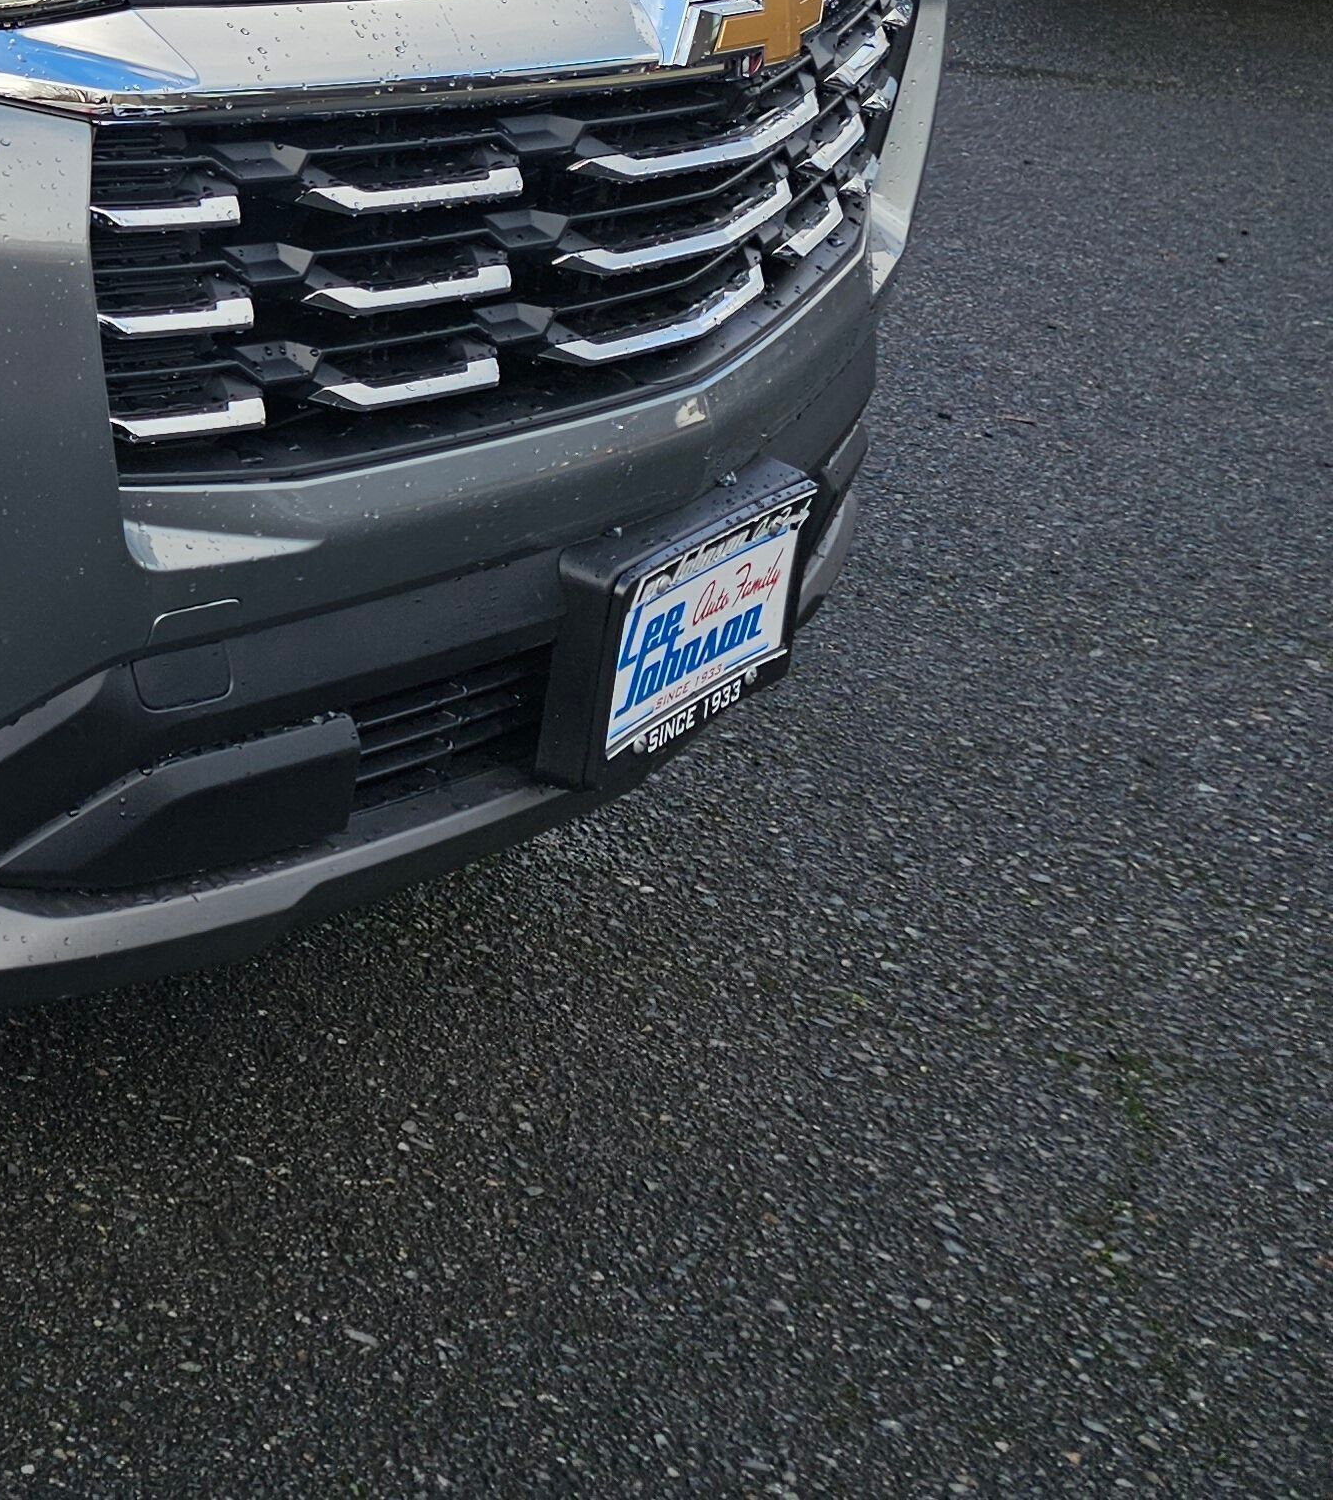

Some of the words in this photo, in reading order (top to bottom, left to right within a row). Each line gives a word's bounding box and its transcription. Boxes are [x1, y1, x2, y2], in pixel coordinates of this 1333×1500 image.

[691, 579, 730, 626] Auto
[732, 548, 784, 607] Family
[613, 602, 764, 720] Johnson
[617, 601, 686, 671] Lee
[646, 706, 697, 753] SINCE
[702, 679, 742, 719] 1933
[654, 680, 691, 710] SINCE
[694, 662, 723, 687] 1933
